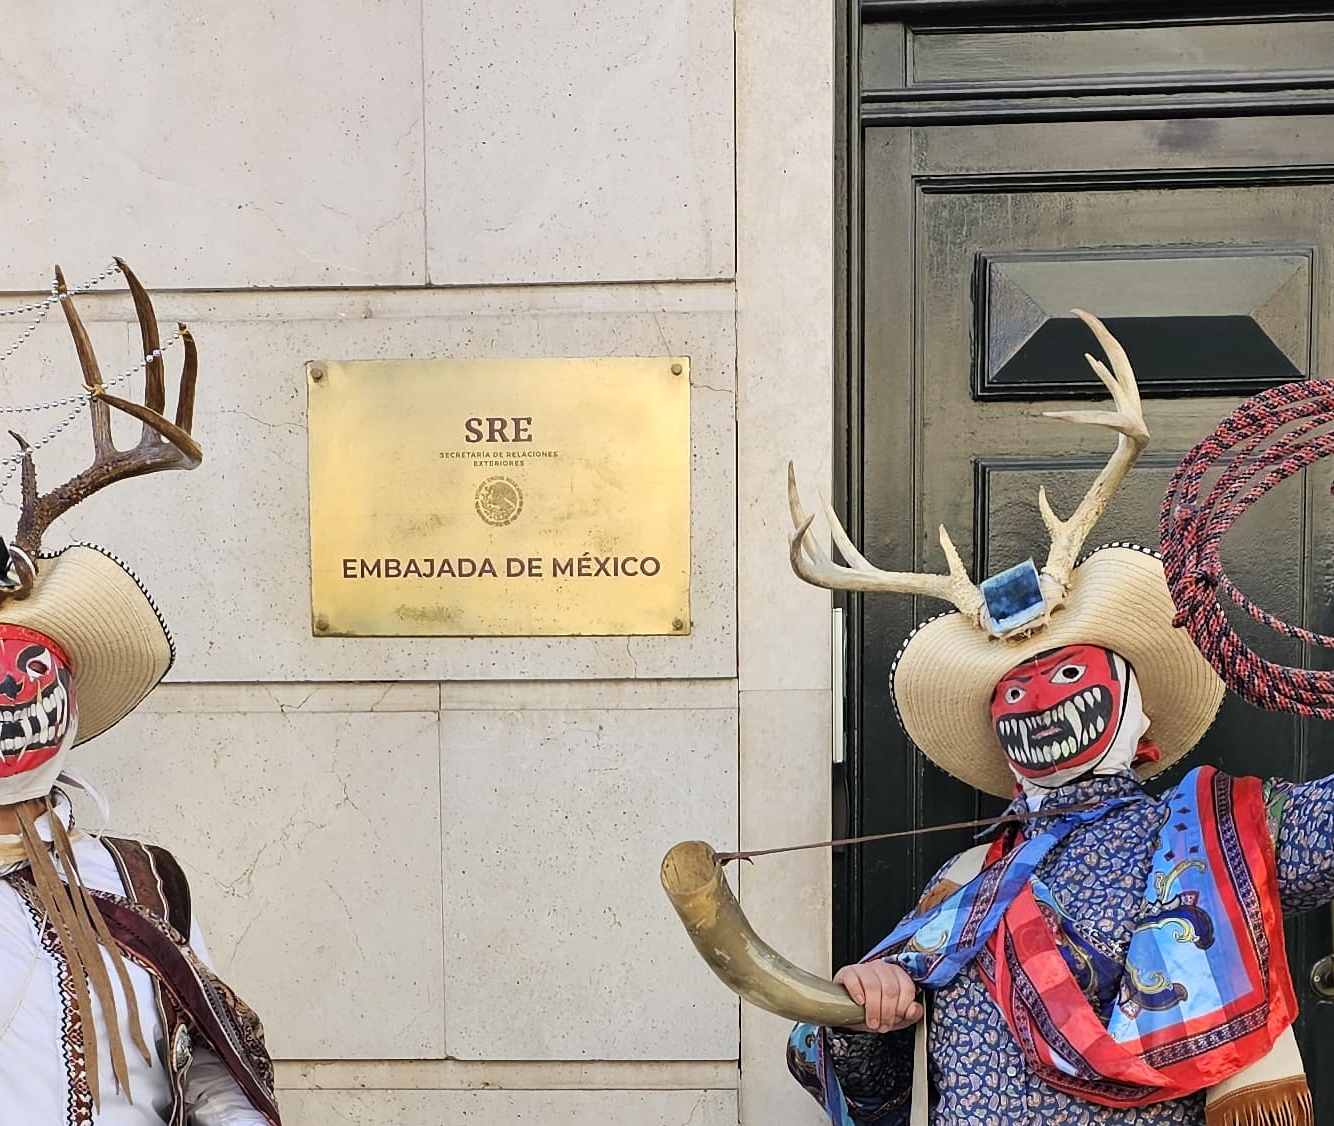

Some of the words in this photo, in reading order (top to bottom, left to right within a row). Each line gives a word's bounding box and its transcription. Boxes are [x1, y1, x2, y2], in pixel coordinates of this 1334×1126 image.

[464, 417, 533, 443] SRE
[439, 449, 491, 459] SECRETARÍA
[342, 558, 498, 579] EMBAJADA
[506, 557, 543, 578] DE
[552, 552, 661, 578] MÉXICO
